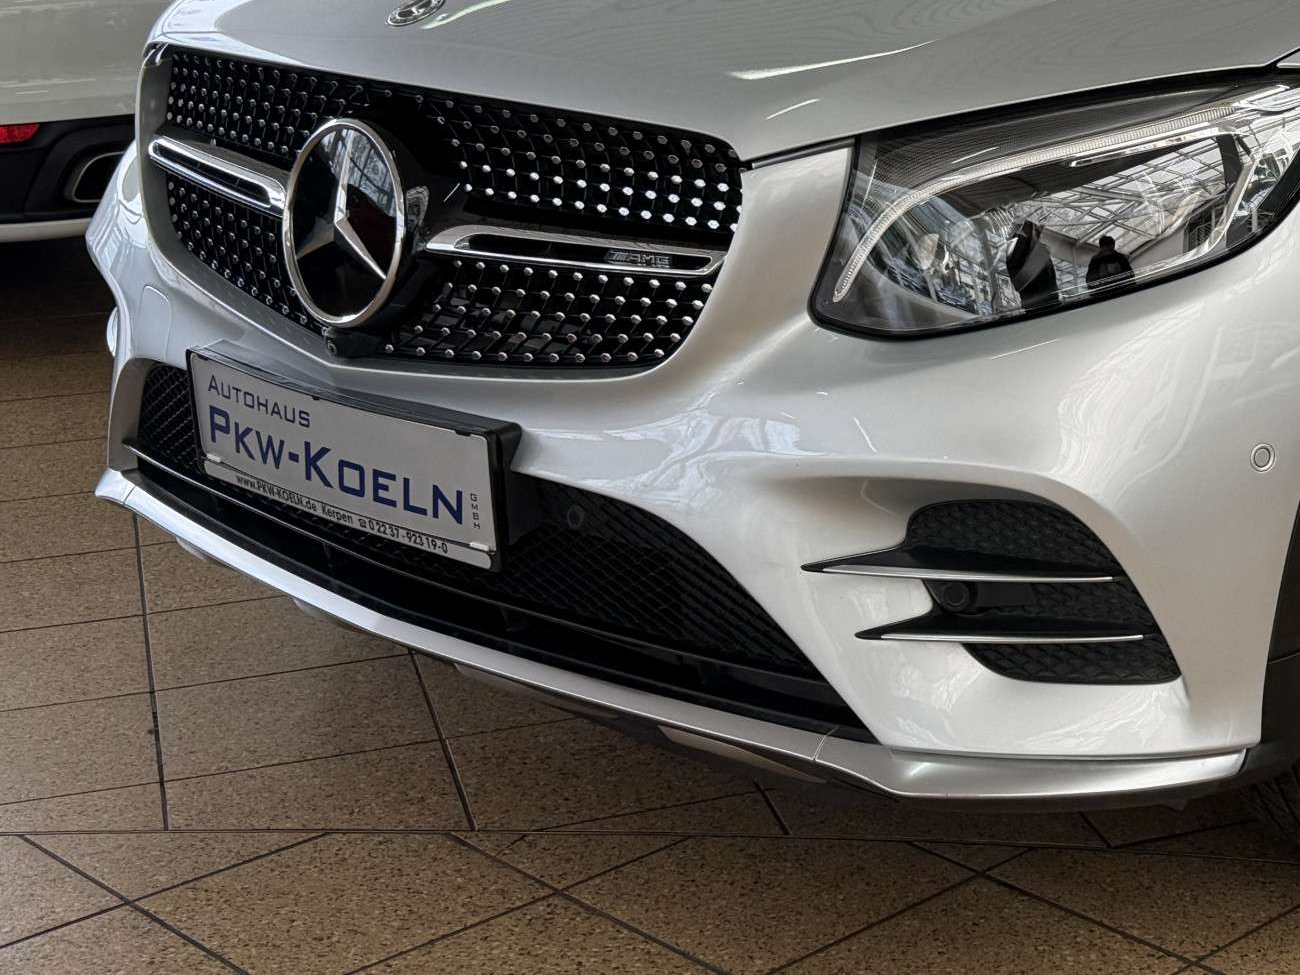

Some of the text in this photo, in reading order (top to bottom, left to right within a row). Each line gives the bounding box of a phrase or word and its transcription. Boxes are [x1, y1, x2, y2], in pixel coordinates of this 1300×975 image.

[627, 251, 671, 269] AMG
[207, 375, 311, 428] AUTOHAUS
[208, 405, 463, 525] PKW-KOELN
[321, 505, 354, 525] Kerpen
